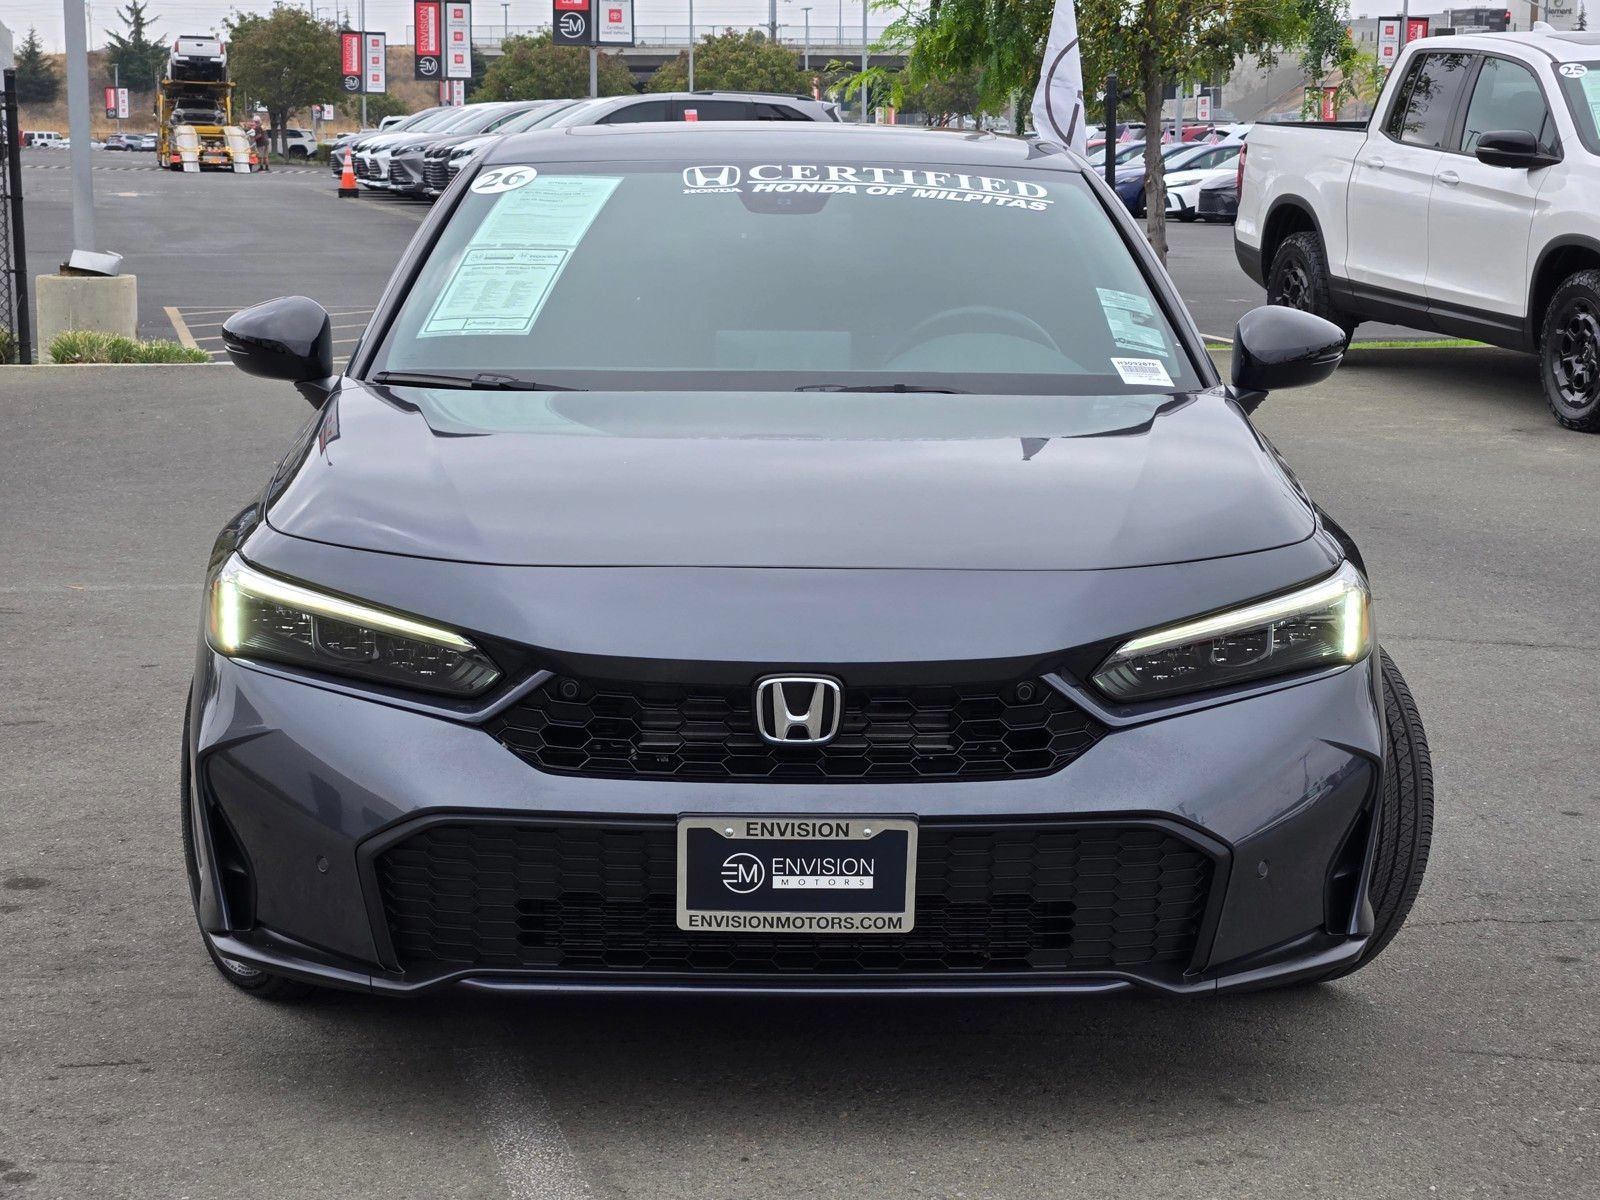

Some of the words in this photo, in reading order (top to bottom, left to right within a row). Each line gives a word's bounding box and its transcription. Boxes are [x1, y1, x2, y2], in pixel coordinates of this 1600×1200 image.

[1549, 7, 1573, 15] lement
[420, 6, 428, 51] ENVISION
[1562, 65, 1585, 75] 25
[475, 169, 530, 189] 26
[749, 165, 1048, 199] CERTIFIED
[752, 183, 857, 195] HONDA
[866, 187, 907, 196] OF
[912, 189, 1048, 212] MILPITAS
[745, 821, 851, 838] ENVISION
[772, 857, 875, 876] ENVISION
[781, 878, 865, 887] MOTORS
[688, 914, 903, 931] ENVISIONMOTORS.COM
